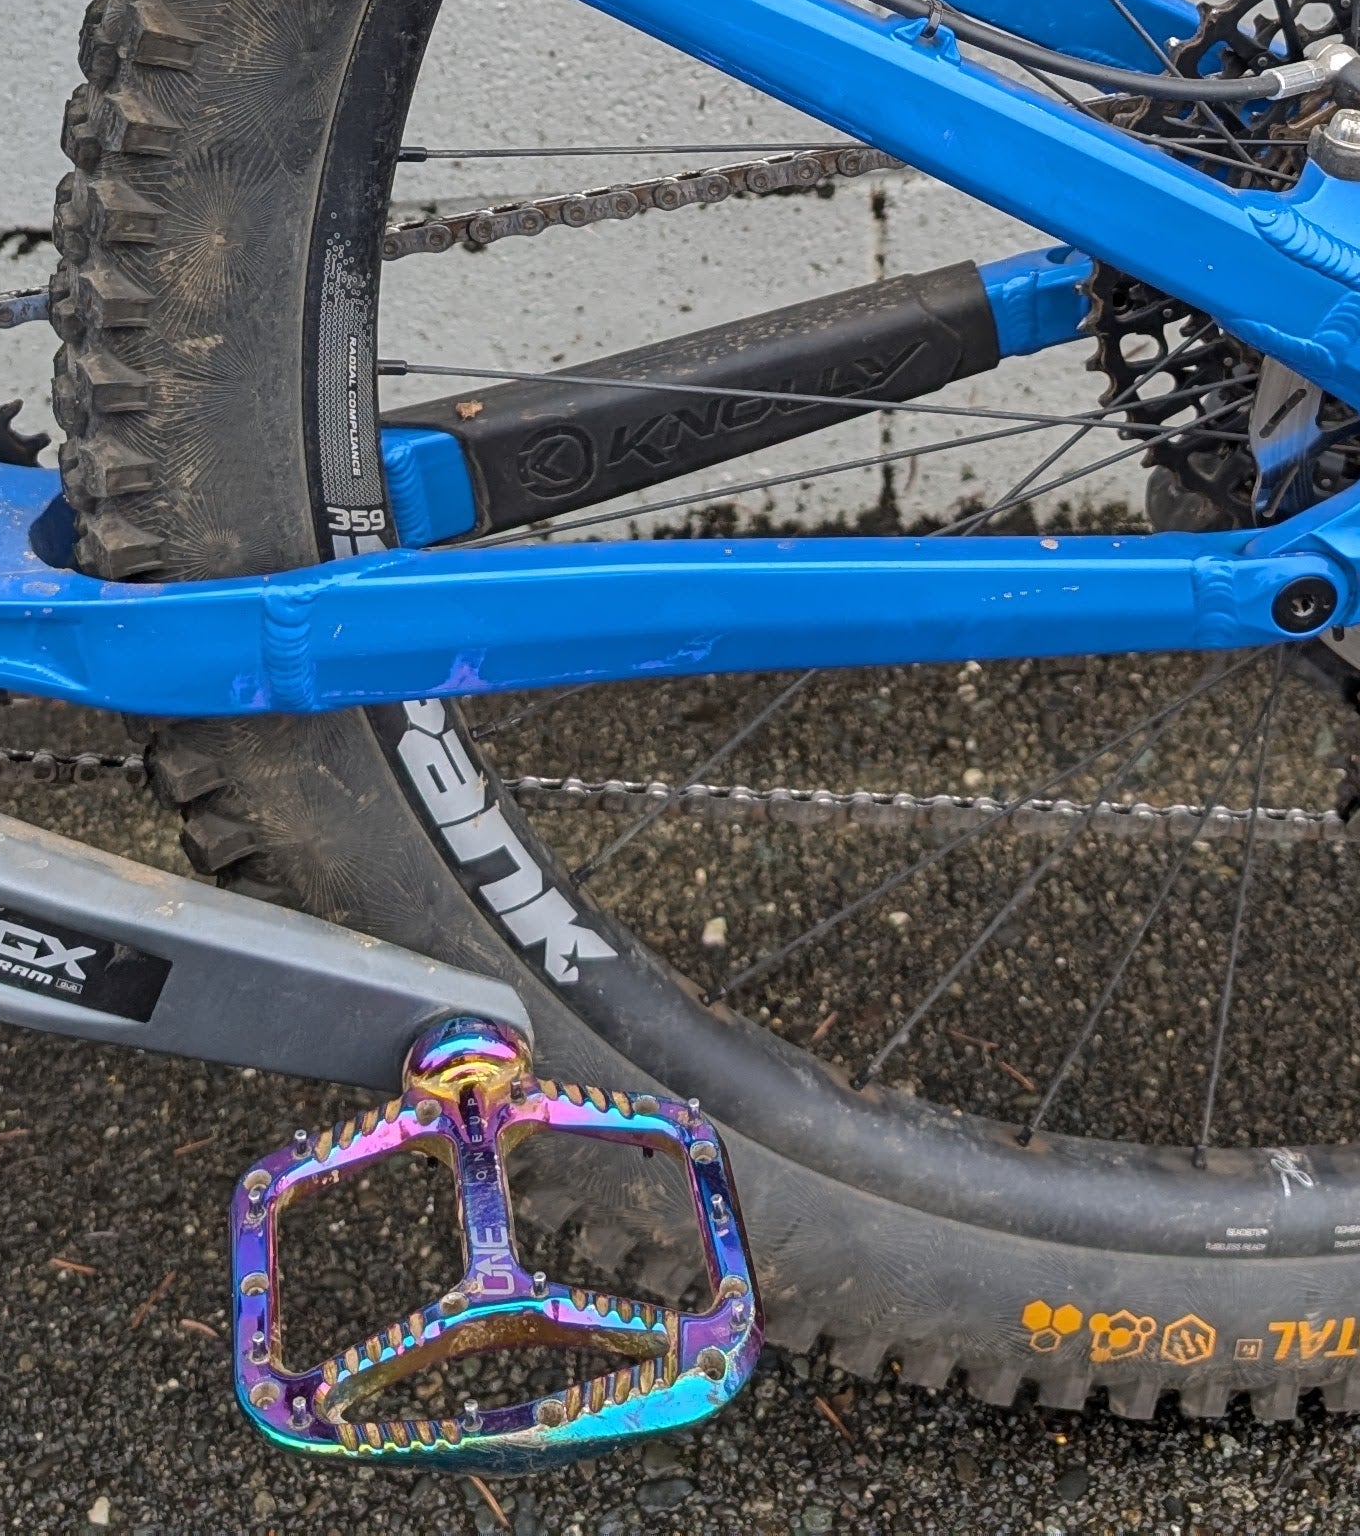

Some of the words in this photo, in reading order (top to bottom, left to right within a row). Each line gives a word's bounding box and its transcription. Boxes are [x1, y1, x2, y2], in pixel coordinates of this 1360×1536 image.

[349, 335, 357, 388] RADIAL
[348, 389, 362, 478] COMPLIANCE
[607, 339, 928, 468] KNOLLY
[326, 506, 386, 532] 359
